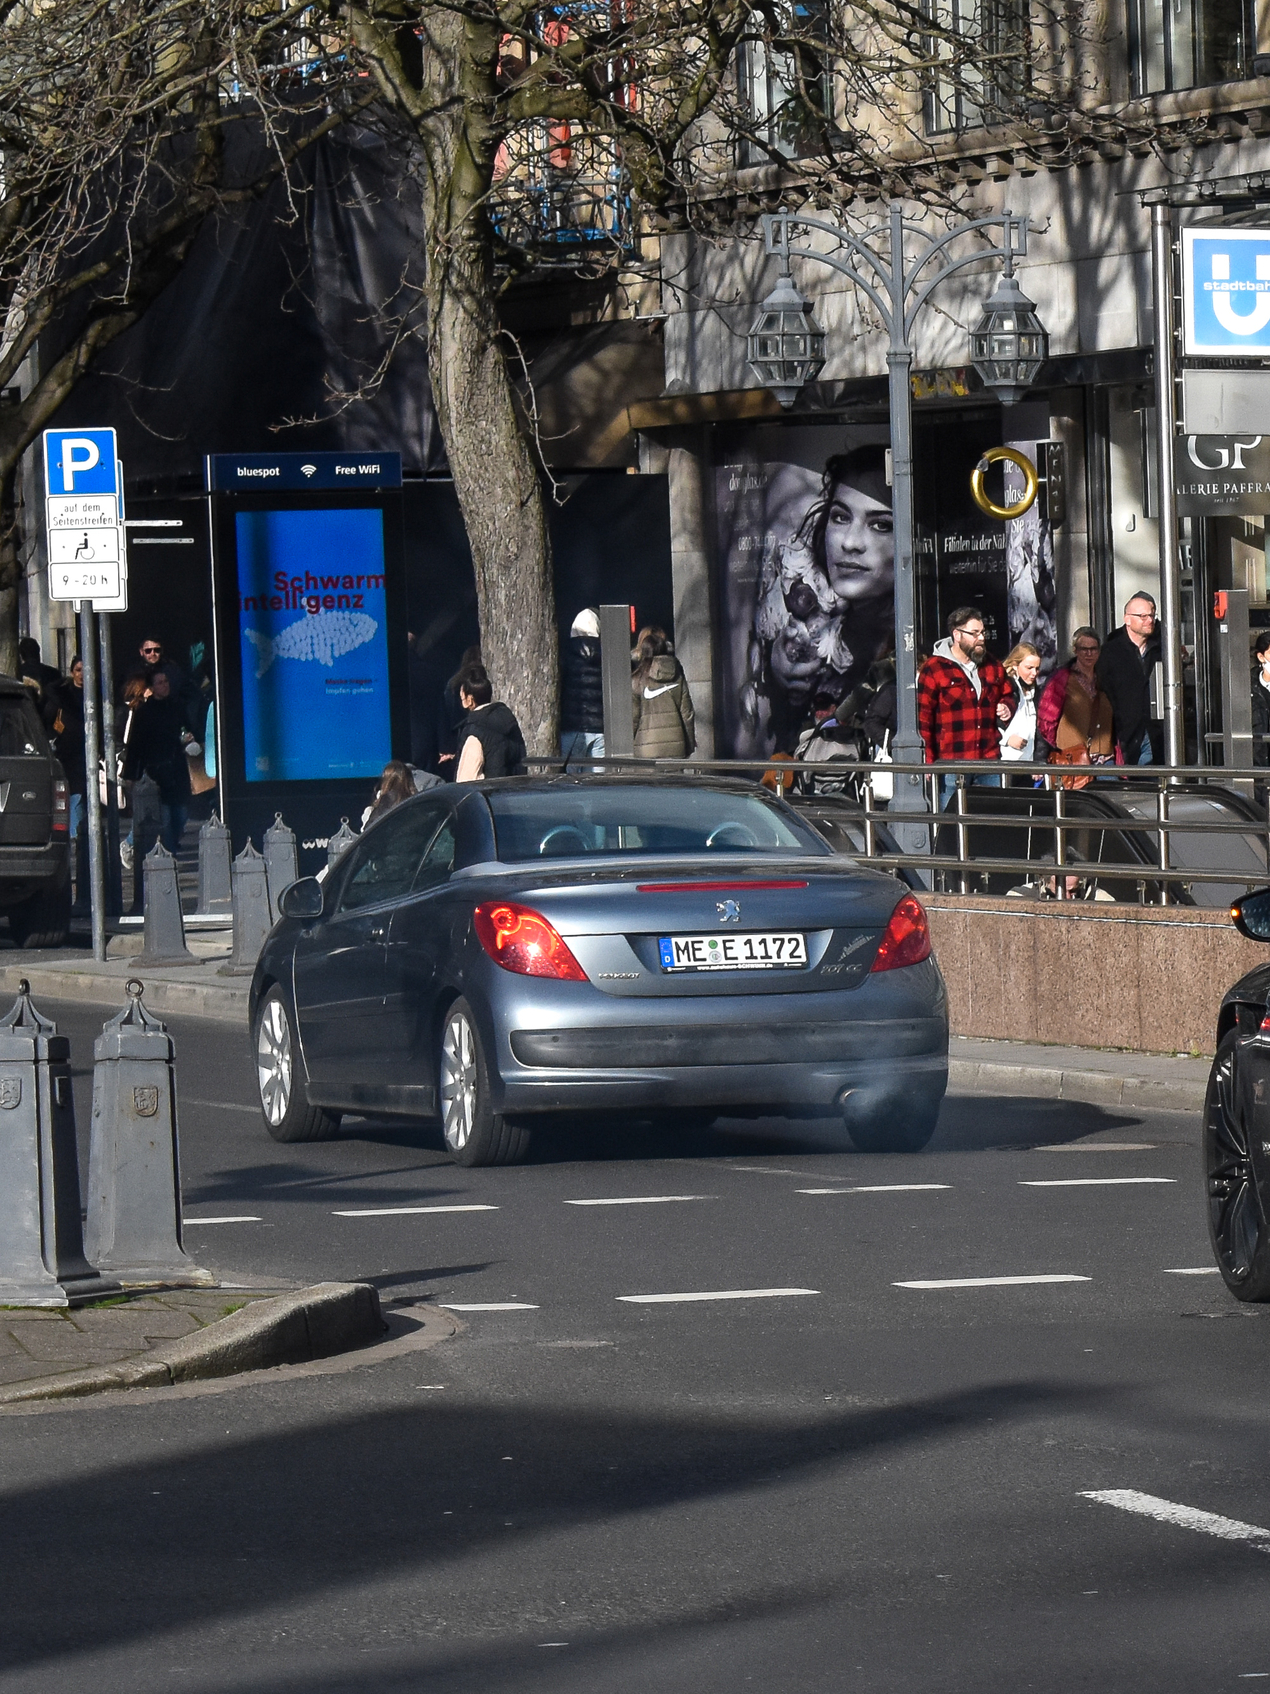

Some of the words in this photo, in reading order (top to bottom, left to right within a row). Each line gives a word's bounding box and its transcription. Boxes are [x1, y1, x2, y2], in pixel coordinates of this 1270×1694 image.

[61, 438, 100, 491] P
[237, 467, 280, 478] bluespot
[335, 465, 356, 475] Free
[359, 464, 381, 474] WiFi
[64, 503, 77, 513] auf
[82, 503, 100, 512] dem
[53, 515, 113, 526] Seitenstreifen
[274, 571, 386, 591] Schwarm
[302, 838, 331, 849] ww
[744, 937, 802, 960] 1172
[664, 955, 671, 963] D
